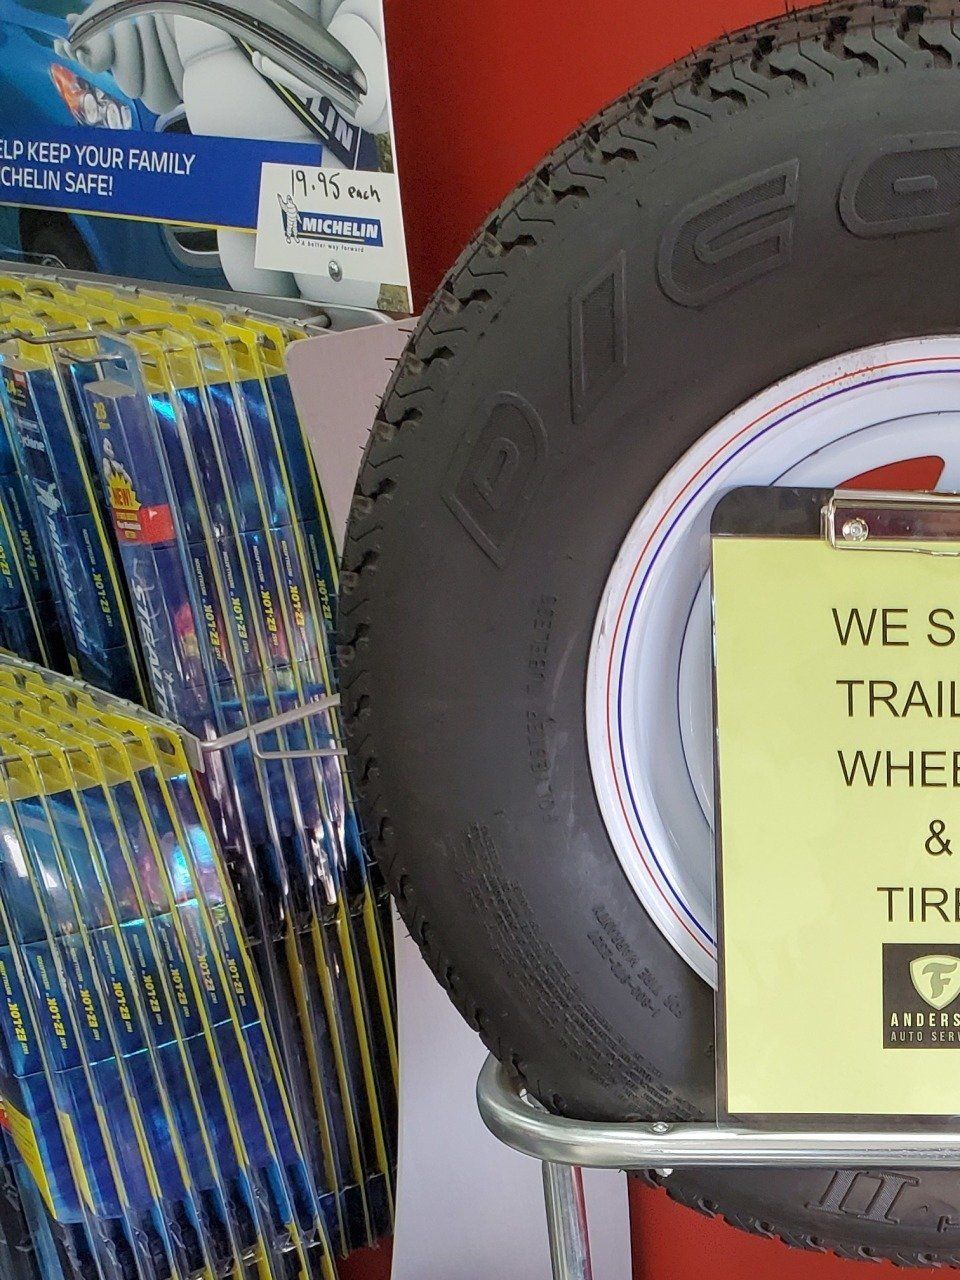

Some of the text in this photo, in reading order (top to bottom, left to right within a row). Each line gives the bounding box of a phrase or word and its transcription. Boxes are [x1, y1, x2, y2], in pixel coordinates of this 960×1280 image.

[27, 141, 71, 164] KEEP
[75, 144, 123, 170] YOUR
[128, 149, 196, 175] FAMILY
[65, 172, 113, 196] SAFE!
[291, 169, 381, 203] 19.95 each
[302, 217, 379, 239] MICHELIN
[832, 607, 909, 646] WE
[924, 819, 953, 856] &
[891, 1031, 923, 1042] AUTO
